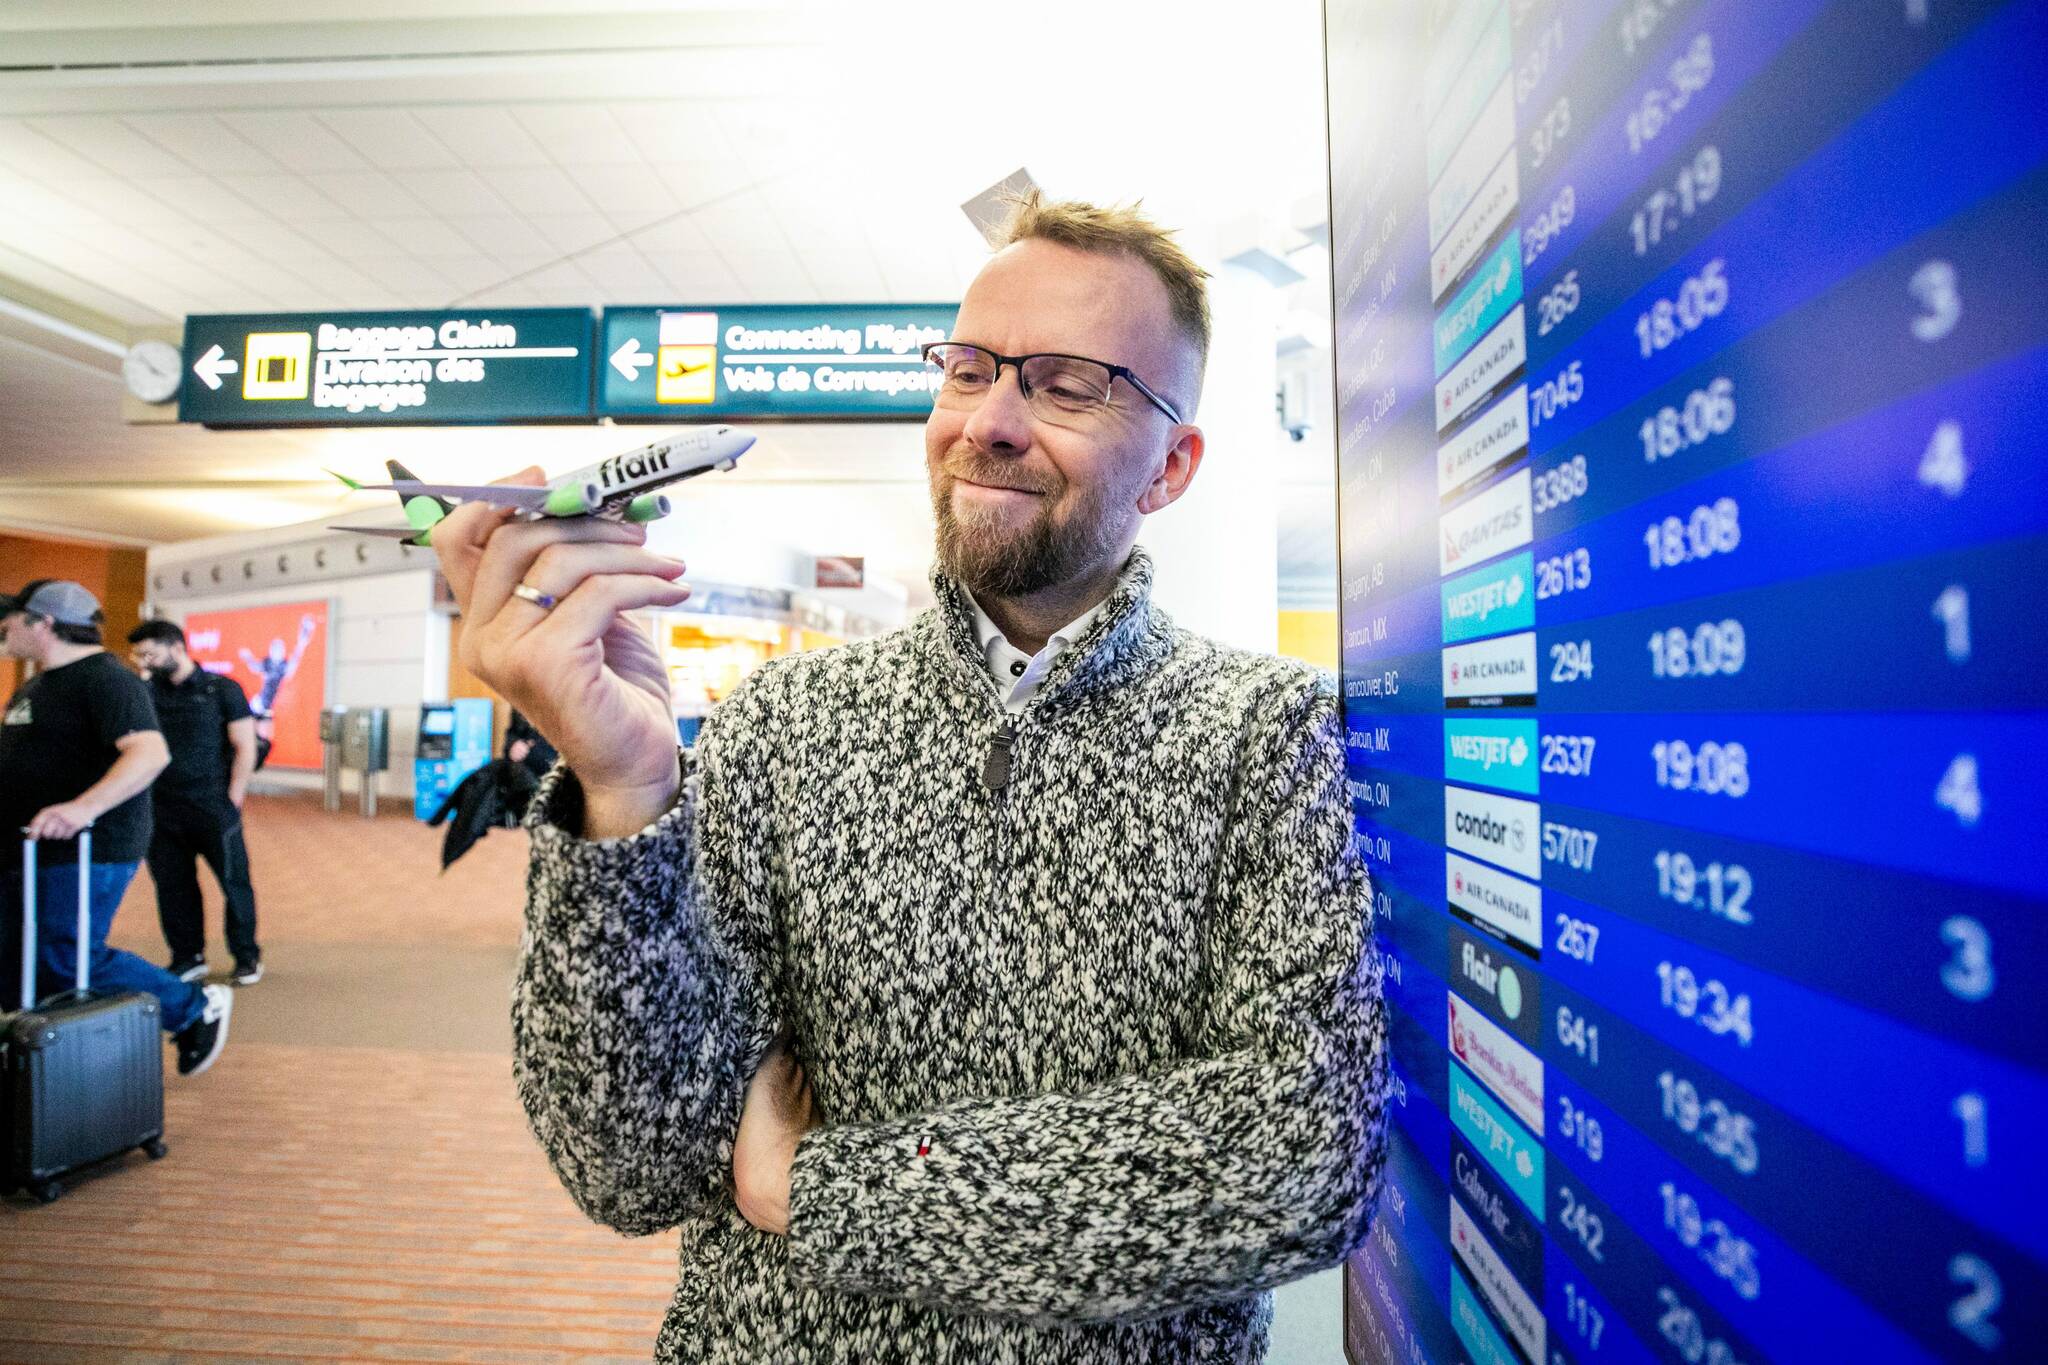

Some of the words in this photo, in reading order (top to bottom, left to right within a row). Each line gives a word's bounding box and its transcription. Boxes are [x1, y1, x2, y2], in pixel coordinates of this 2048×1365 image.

[1523, 186, 1576, 267] 2949
[1630, 145, 1722, 256] 17:19
[1538, 269, 1580, 336] 265
[1908, 259, 1962, 342] 3
[317, 323, 436, 353] Baggage
[438, 320, 517, 348] Claim
[725, 325, 862, 354] Connecting
[865, 323, 946, 354] Flights
[315, 355, 433, 383] Livraison
[435, 354, 486, 382] des
[723, 366, 776, 392] Vols
[777, 366, 811, 391] de
[1454, 376, 1471, 400] AIR
[1471, 338, 1516, 386] CANADA
[1530, 360, 1584, 427] 7045
[1373, 386, 1396, 422] Cuba
[599, 443, 672, 488] flair
[1456, 447, 1473, 469] AIR
[1474, 416, 1519, 457] CANADA
[1916, 418, 1968, 497] 4
[1533, 455, 1588, 514] 3388
[1459, 504, 1523, 554] QANTAS
[1643, 497, 1741, 570] 18:08
[1371, 562, 1384, 590] AB
[1447, 579, 1506, 621] WESTJET
[1535, 548, 1592, 600] 2613
[1373, 614, 1388, 642] MX
[1648, 619, 1746, 678] 18:09
[1931, 583, 1972, 666] 1
[1385, 670, 1399, 696] BC
[1462, 663, 1480, 681] AIR
[1481, 658, 1527, 679] CANADA
[1550, 639, 1594, 683] 294
[1345, 725, 1375, 753] Cancun,
[1375, 728, 1391, 752] MX
[1450, 735, 1511, 771] WESTJET
[1541, 735, 1596, 777] 2537
[1348, 778, 1375, 808] oronto,
[1375, 782, 1390, 808] ON
[1651, 740, 1750, 797] 19:08
[1934, 752, 1983, 829] 4
[1377, 837, 1391, 864] ON
[1455, 811, 1507, 846] condor
[1542, 822, 1598, 872] 5707
[1377, 892, 1392, 921] ON
[1466, 882, 1483, 902] AIR
[1484, 888, 1532, 923] CANADA
[1654, 850, 1754, 924] 19:12
[1556, 912, 1600, 964] 267
[1939, 914, 1995, 1002] 3
[1386, 953, 1401, 986] ON
[1462, 941, 1499, 996] flair
[1655, 961, 1754, 1048] 19:34
[1557, 1006, 1598, 1066] 641
[1457, 1083, 1515, 1161] WESTJET
[1559, 1096, 1603, 1161] 319
[1953, 1093, 1989, 1168] 1
[1392, 1185, 1406, 1226] SK
[1560, 1186, 1604, 1264] 242
[1565, 1283, 1604, 1351] 117
[1948, 1251, 2004, 1351] 2
